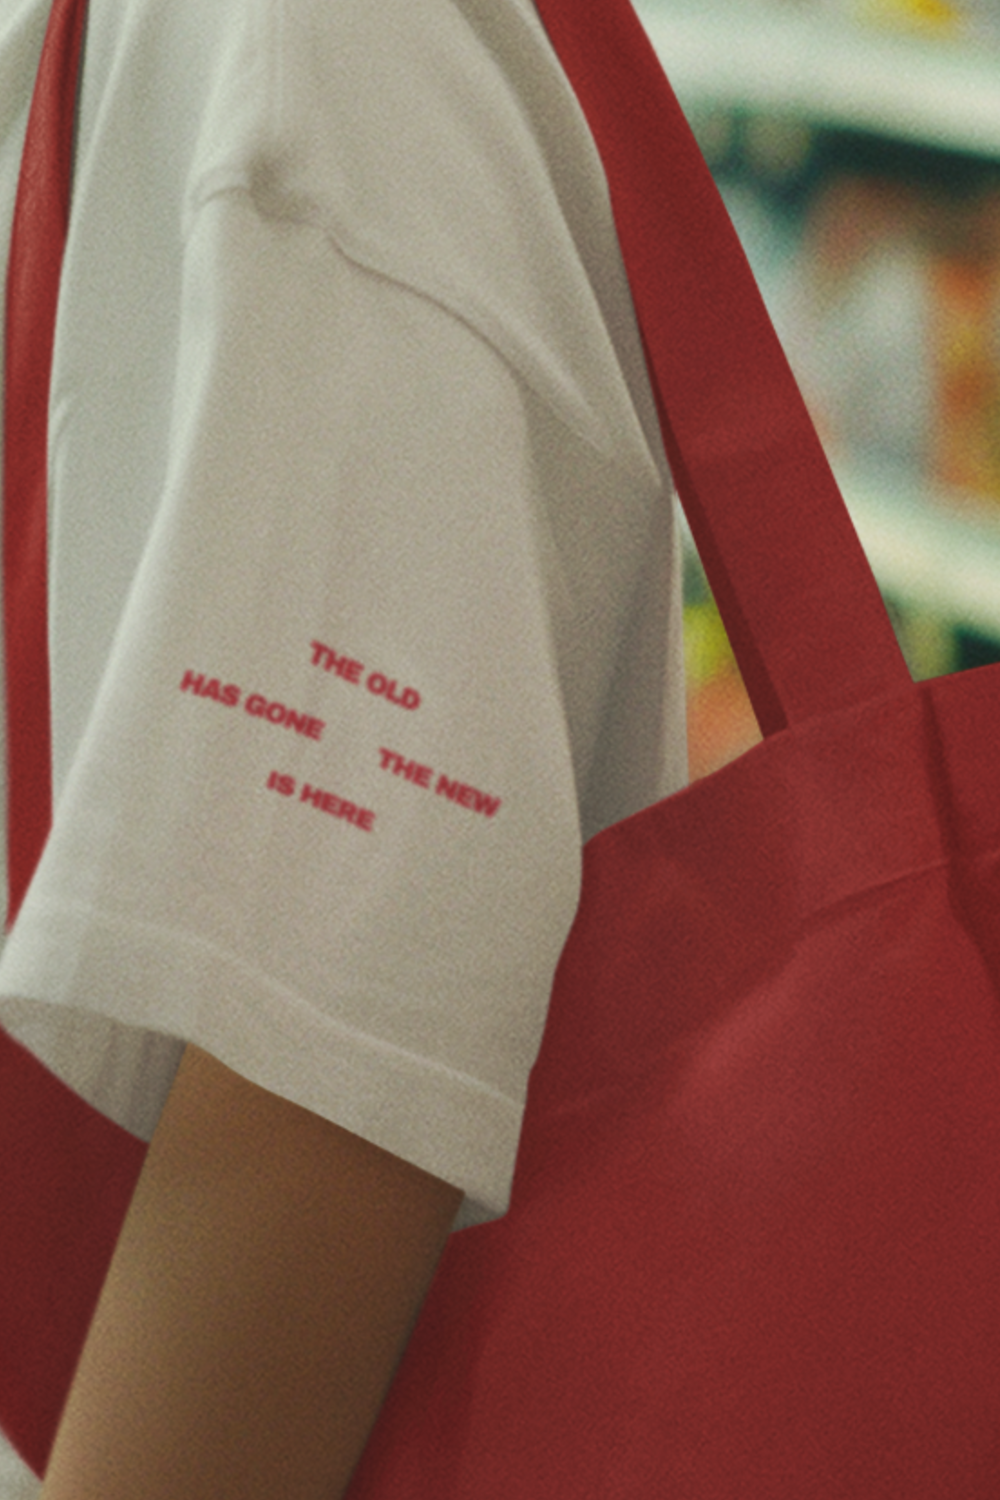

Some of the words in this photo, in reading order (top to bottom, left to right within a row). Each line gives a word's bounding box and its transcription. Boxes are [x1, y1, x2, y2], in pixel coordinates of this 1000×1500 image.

[179, 669, 242, 708] HAS
[244, 693, 326, 741] GONE
[310, 639, 364, 684] THE
[366, 672, 421, 711] OLD
[266, 770, 295, 806] IS
[300, 784, 376, 833] HERE
[378, 746, 434, 789] THE
[435, 775, 502, 818] NEW
